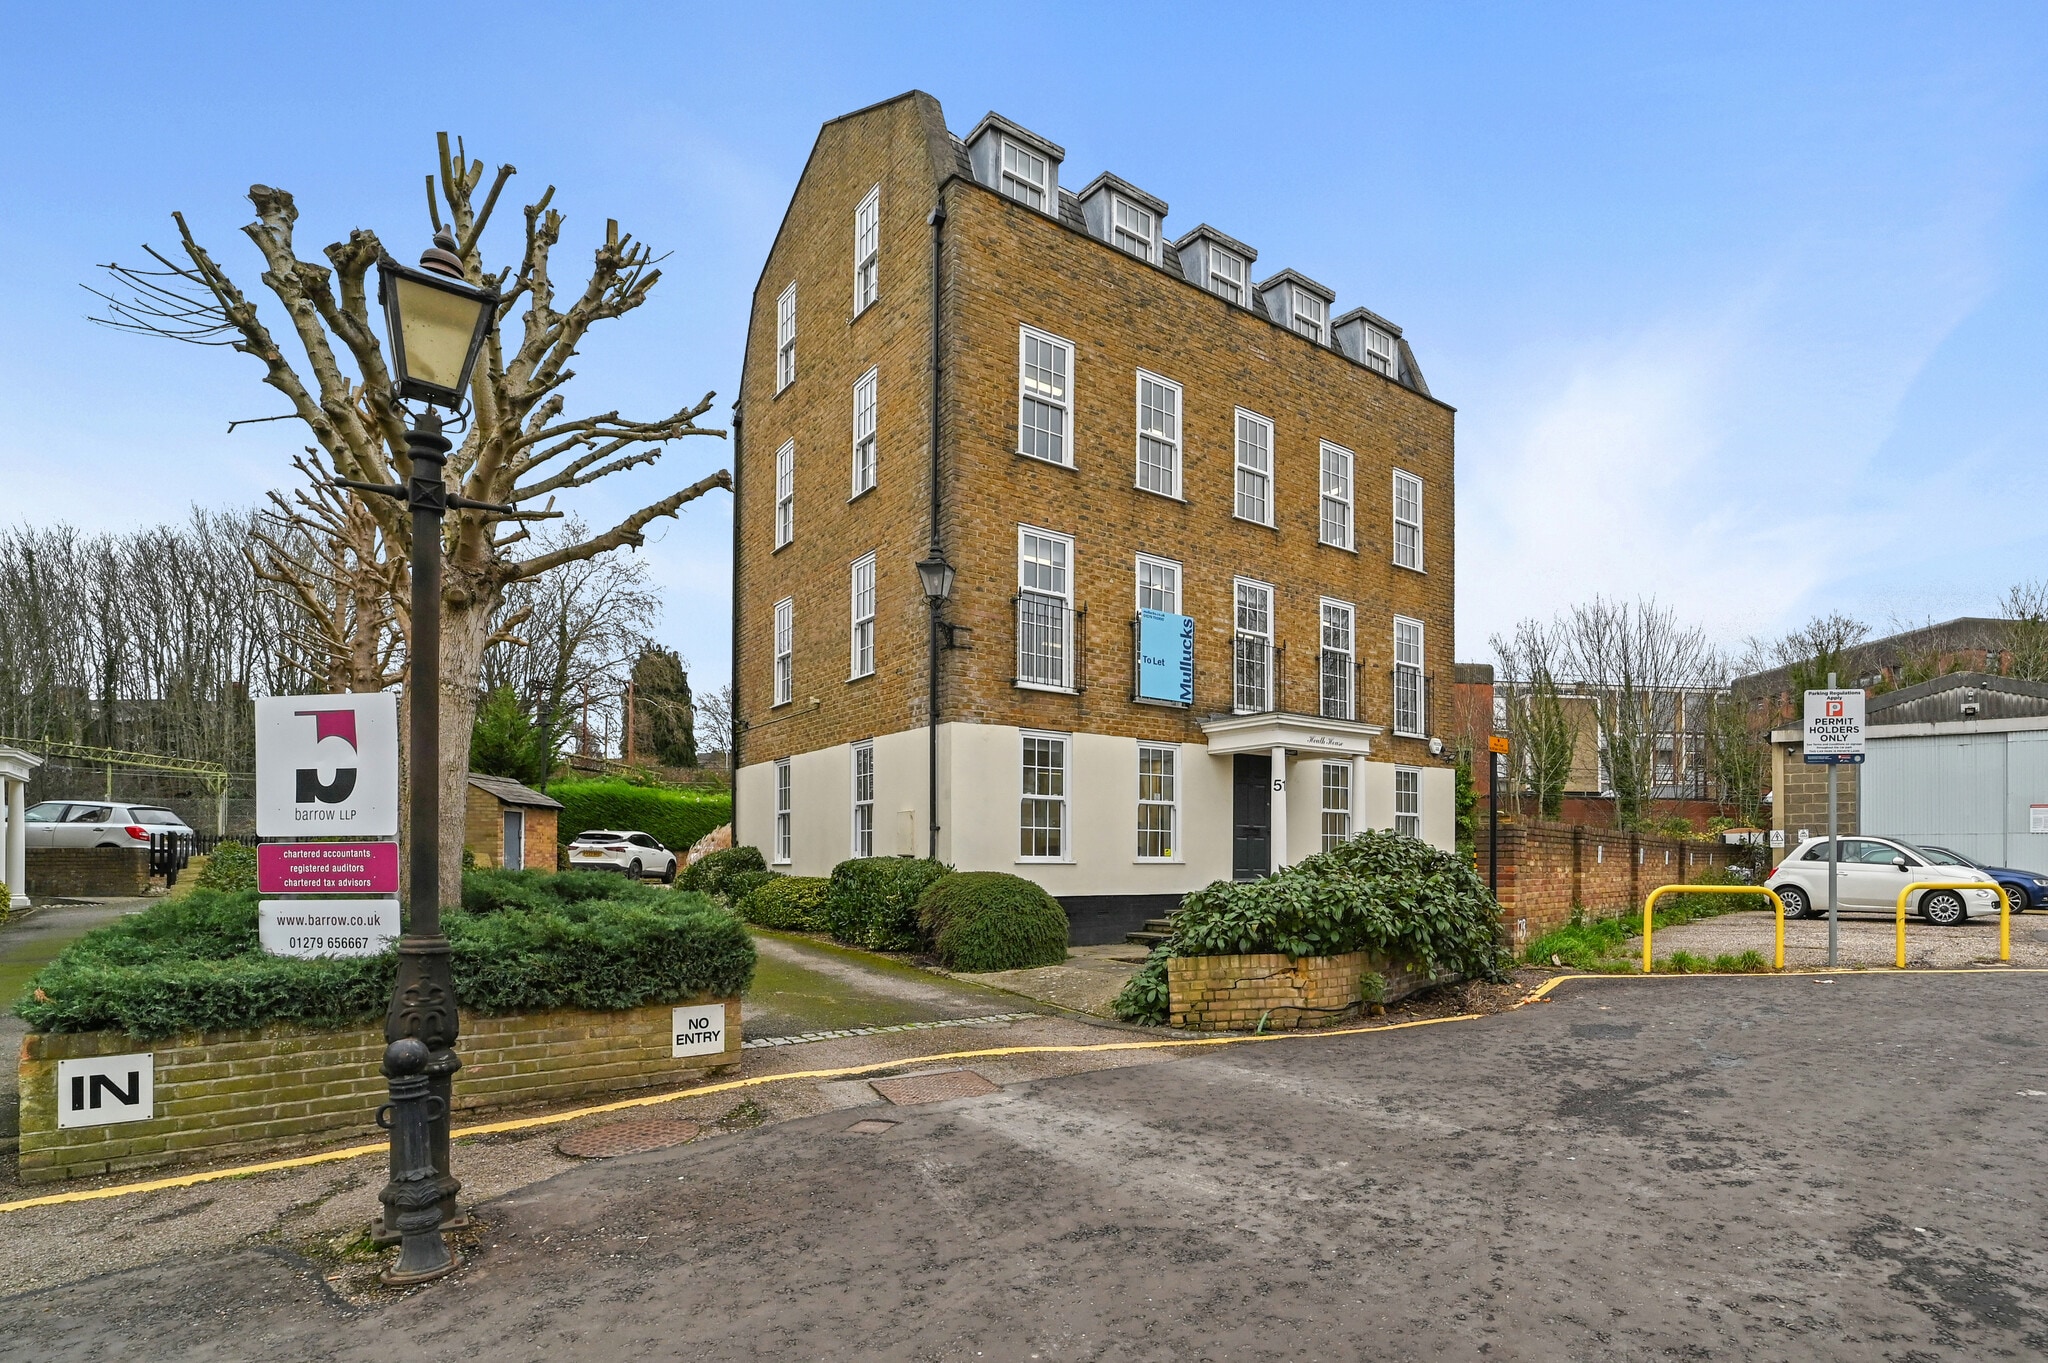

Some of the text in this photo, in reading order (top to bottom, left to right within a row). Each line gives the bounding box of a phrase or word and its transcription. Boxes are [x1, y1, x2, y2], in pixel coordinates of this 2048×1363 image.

[1143, 655, 1165, 667] To Let
[1180, 618, 1193, 701] Mullucks
[1815, 718, 1854, 726] PERMIT
[1809, 726, 1860, 734] HOLDERS
[1820, 734, 1848, 742] ONLY
[294, 808, 357, 821] barrow LLP
[283, 849, 371, 859] chartered accountants
[290, 863, 365, 875] registered auditors
[284, 878, 371, 887] chartered tax advisors
[277, 914, 381, 926] www.barrow.co.uk
[289, 937, 369, 949] 01279 656667
[688, 1017, 709, 1030] NO
[676, 1030, 721, 1046] ENTRY
[72, 1071, 140, 1111] IN
